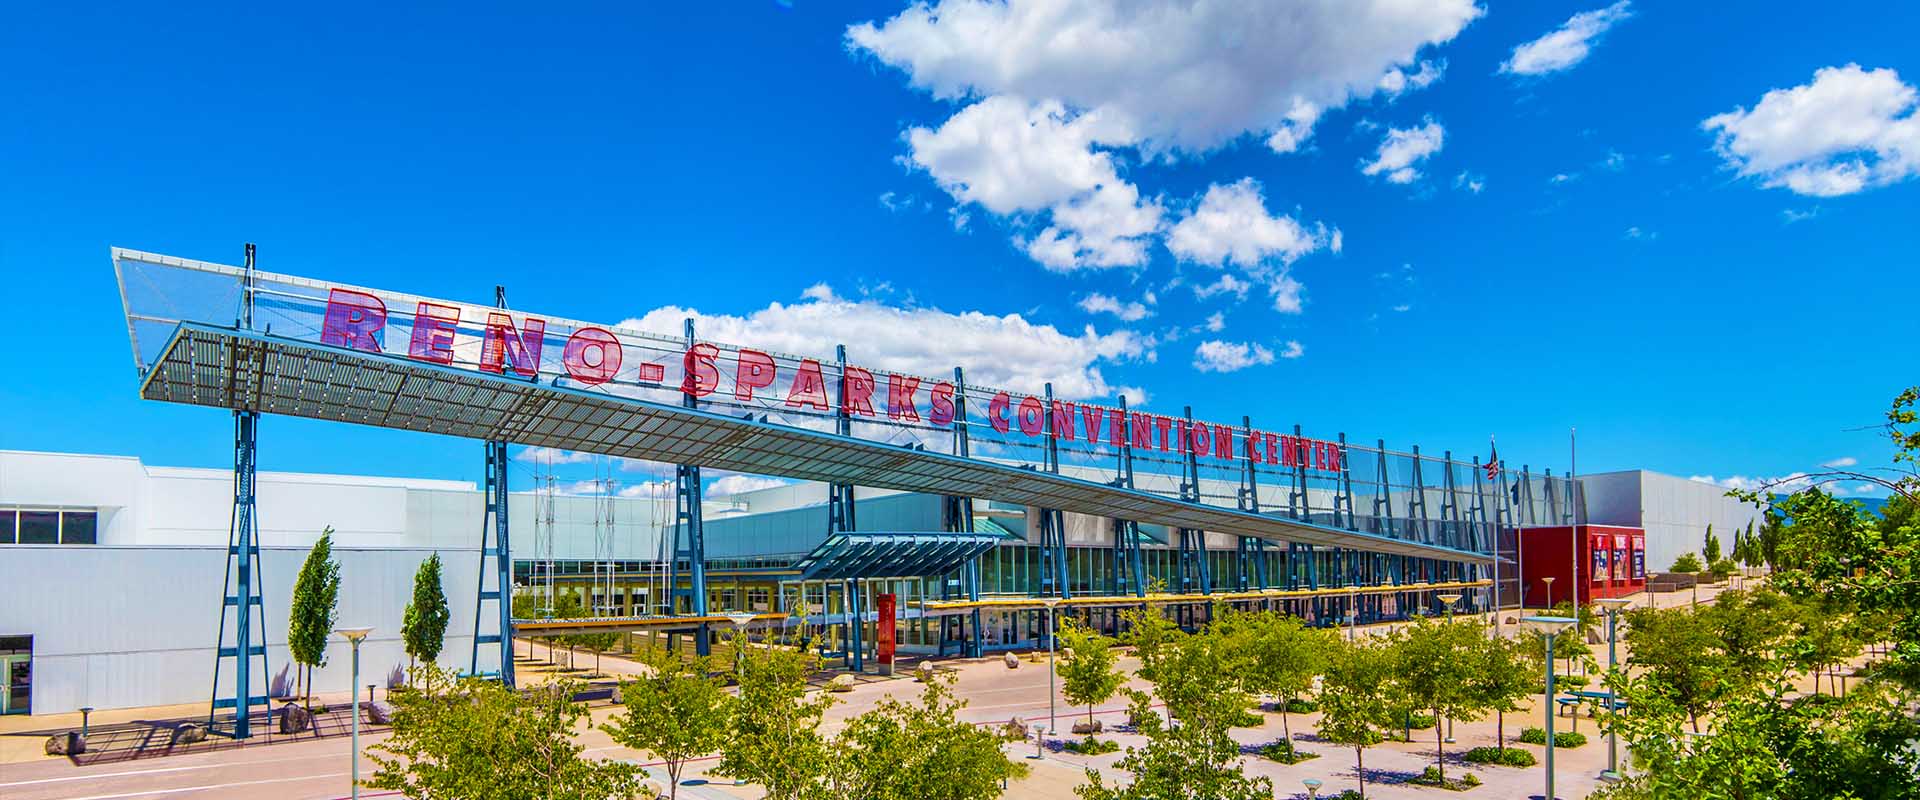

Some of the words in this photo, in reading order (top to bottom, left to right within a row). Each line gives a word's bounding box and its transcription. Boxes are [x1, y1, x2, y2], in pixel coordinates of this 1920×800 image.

[320, 287, 956, 426] RENO-SPARKS
[988, 391, 1233, 460] CONVENTION
[1250, 430, 1341, 472] CENTER
